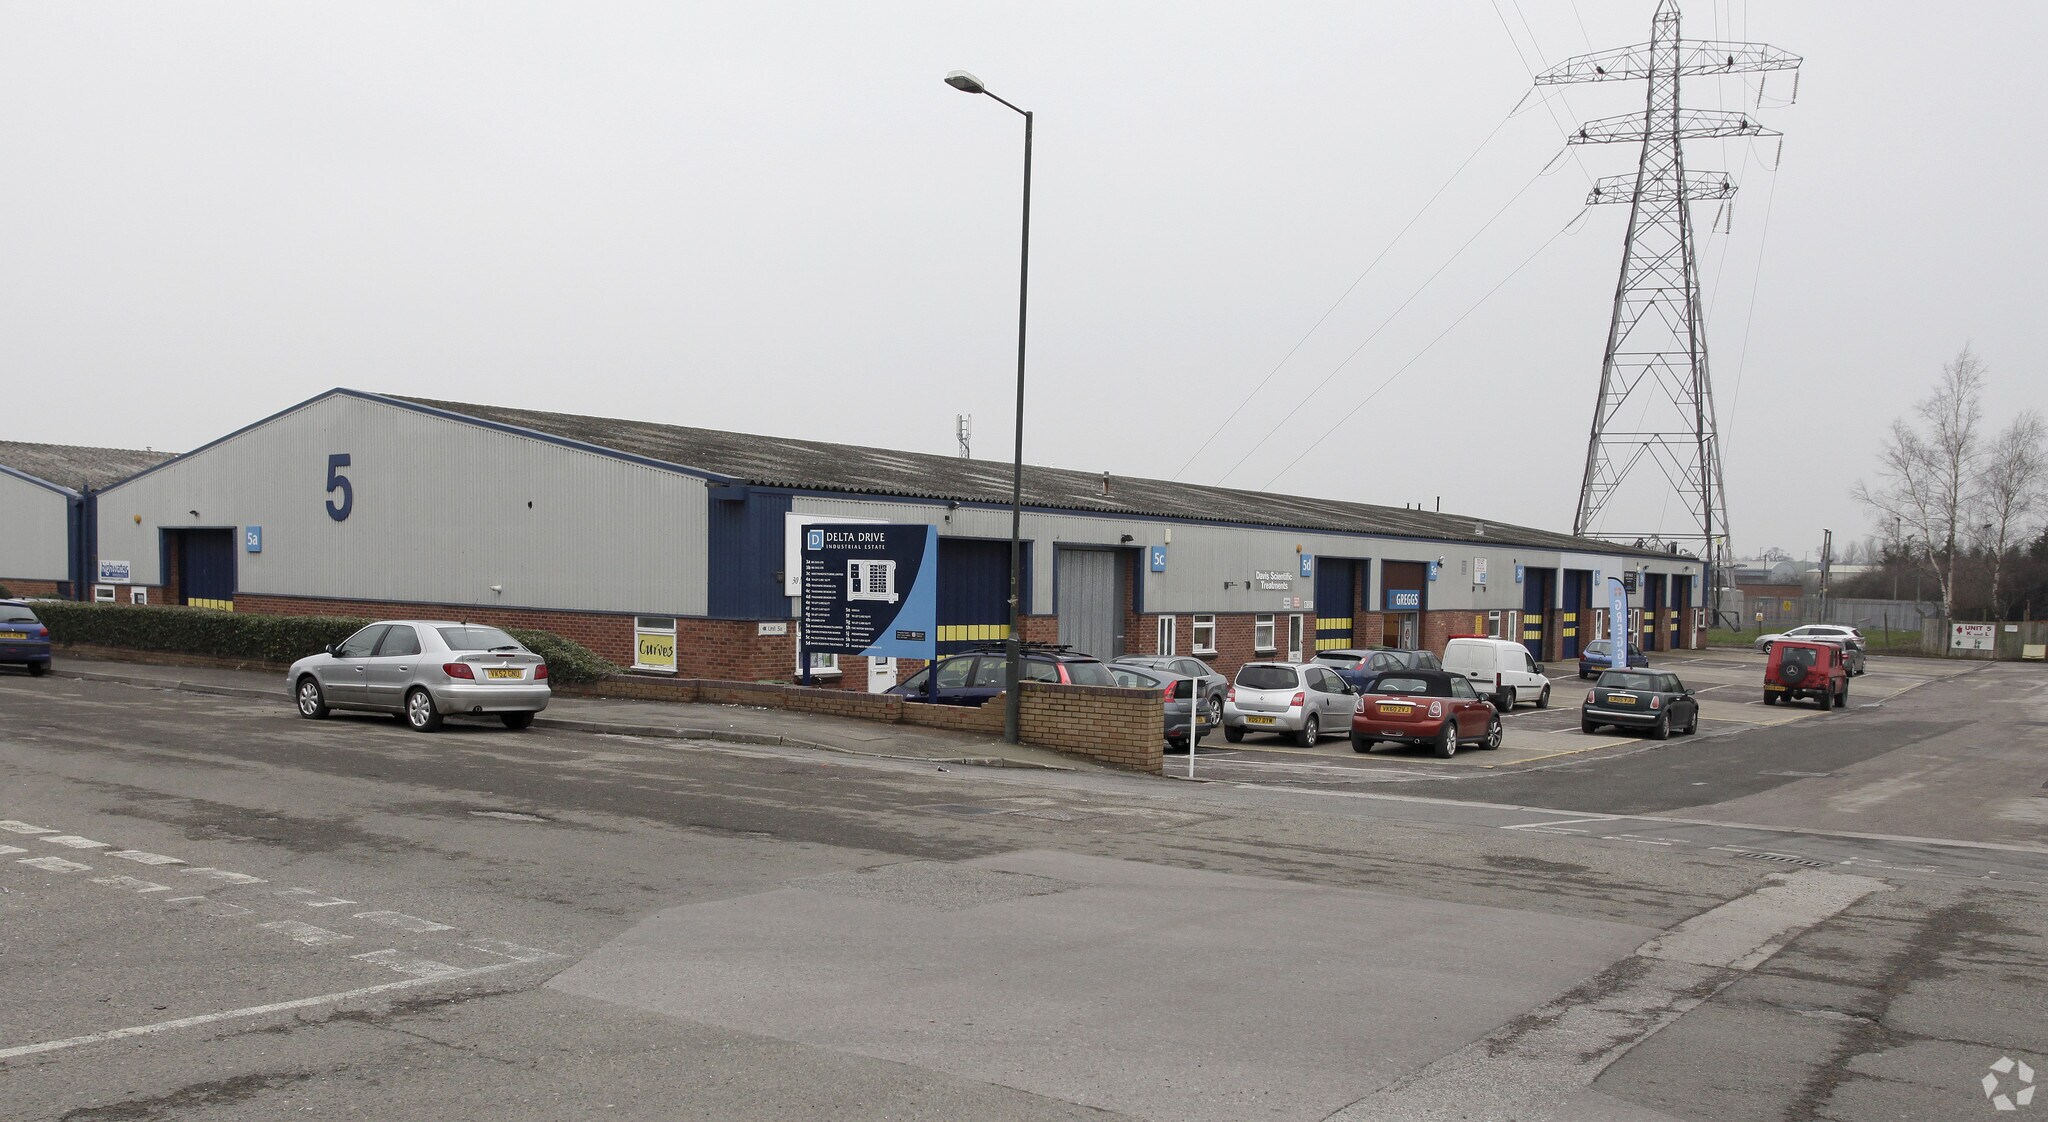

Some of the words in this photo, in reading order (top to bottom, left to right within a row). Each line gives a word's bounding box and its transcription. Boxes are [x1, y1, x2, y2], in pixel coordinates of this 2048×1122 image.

[326, 453, 352, 522] 5
[248, 532, 258, 546] 5a
[812, 534, 820, 544] D
[826, 532, 854, 542] DELTA
[858, 532, 885, 542] DRIVE
[1154, 552, 1164, 566] 5c
[1302, 558, 1311, 571] 5d
[101, 562, 129, 576] highwater
[1431, 566, 1437, 576] 5e
[1255, 571, 1270, 580] Davis
[1270, 571, 1293, 581] Scientific
[1261, 581, 1288, 590] Treatments
[1396, 593, 1418, 606] GREGGS
[640, 640, 673, 657] Curves
